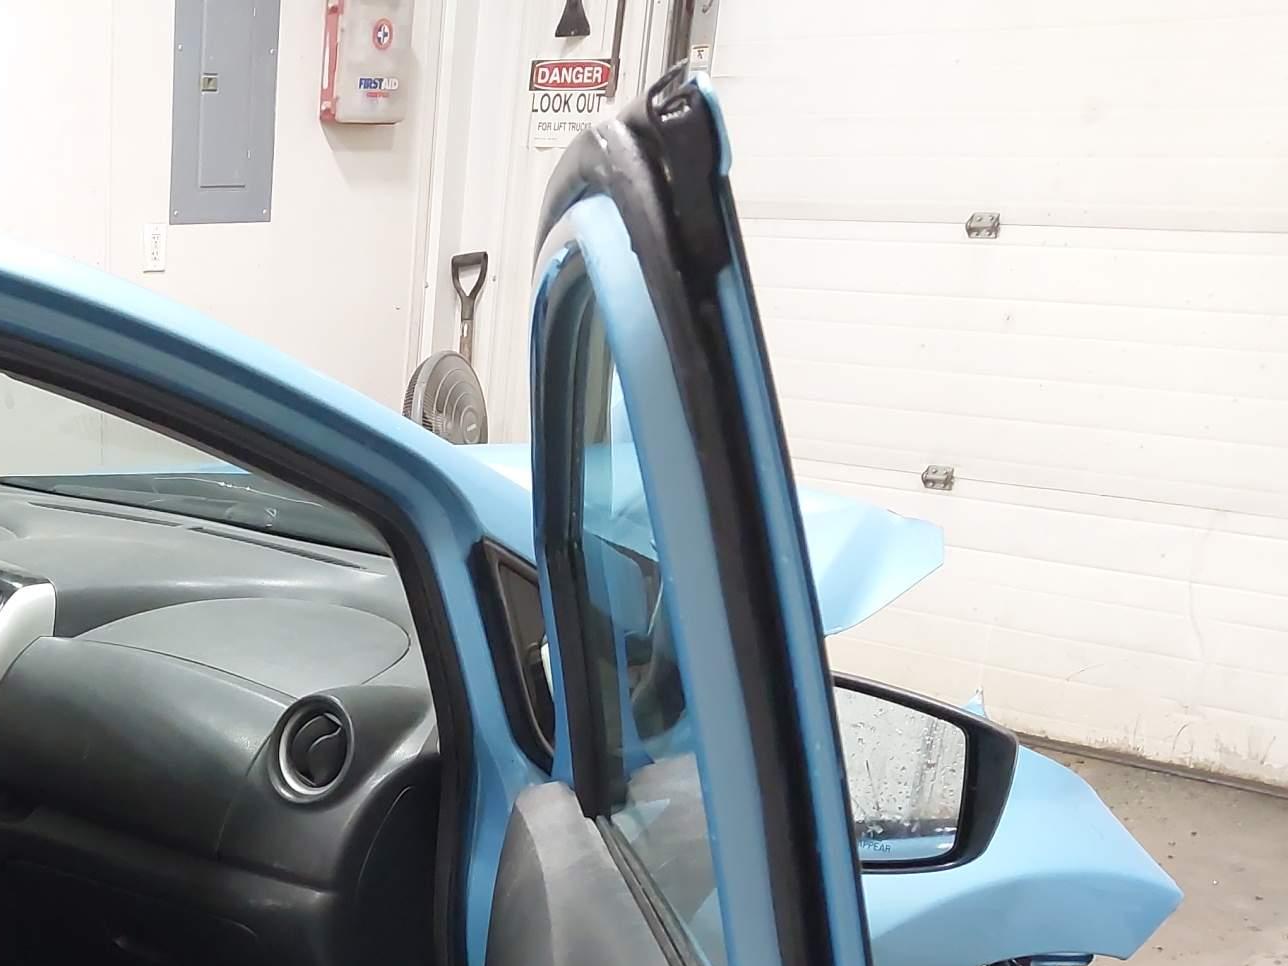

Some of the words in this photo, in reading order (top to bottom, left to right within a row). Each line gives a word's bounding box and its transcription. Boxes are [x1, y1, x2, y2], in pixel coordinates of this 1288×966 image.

[537, 66, 603, 84] DANGER
[531, 93, 573, 113] LOOK
[576, 93, 605, 113] OUT
[537, 121, 552, 131] FOR
[553, 121, 567, 131] LIFT
